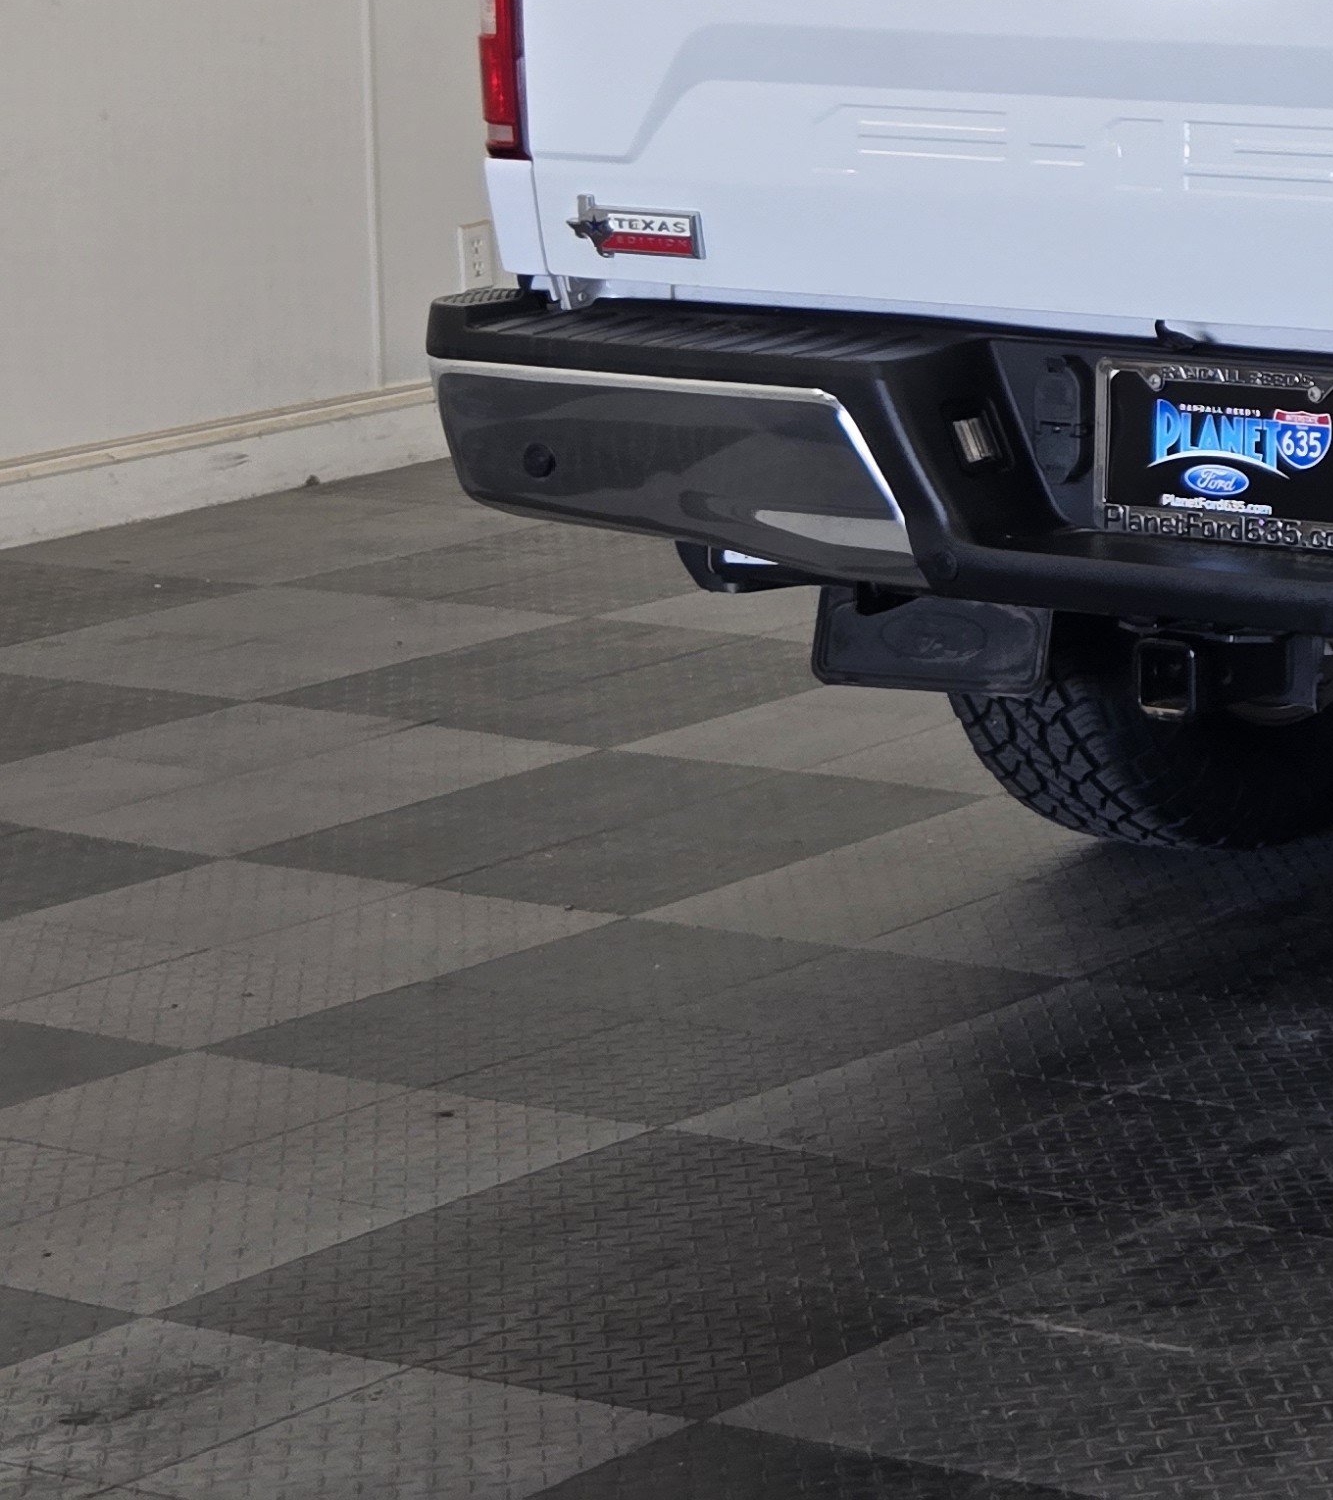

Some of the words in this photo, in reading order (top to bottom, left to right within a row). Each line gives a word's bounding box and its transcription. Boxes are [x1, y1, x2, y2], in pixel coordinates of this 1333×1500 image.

[613, 217, 687, 234] TEXAS
[614, 235, 689, 248] EDITION
[1155, 399, 1281, 470] PLANET
[1282, 430, 1322, 458] 635
[1196, 470, 1237, 492] Ford
